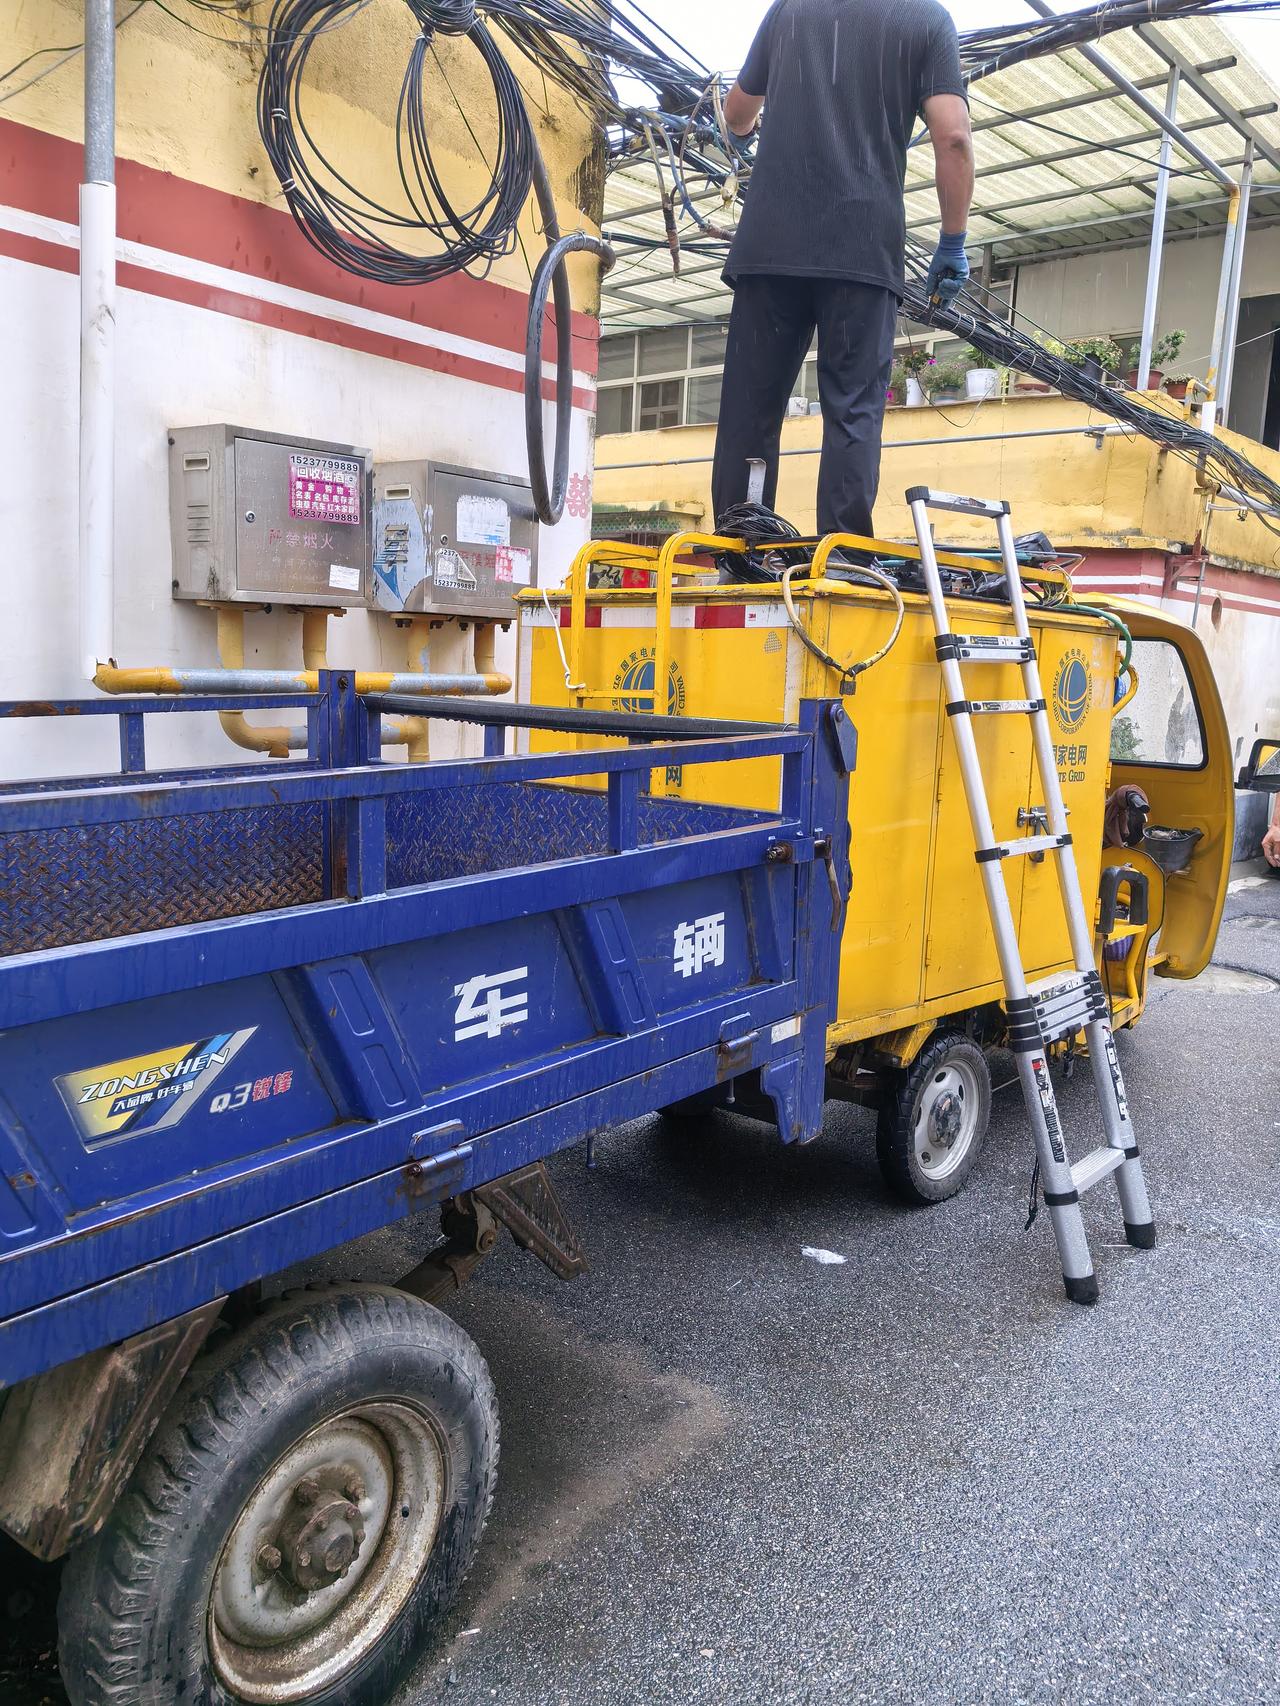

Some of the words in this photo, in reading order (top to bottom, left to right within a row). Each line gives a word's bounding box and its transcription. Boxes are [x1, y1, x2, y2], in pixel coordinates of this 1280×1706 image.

[291, 455, 358, 472] 15237799889
[291, 508, 359, 523] 15237799889
[454, 965, 528, 1043] 车
[673, 911, 725, 979] 辆
[77, 1048, 230, 1104] ZONGSHEN
[209, 1081, 253, 1115] Q3
